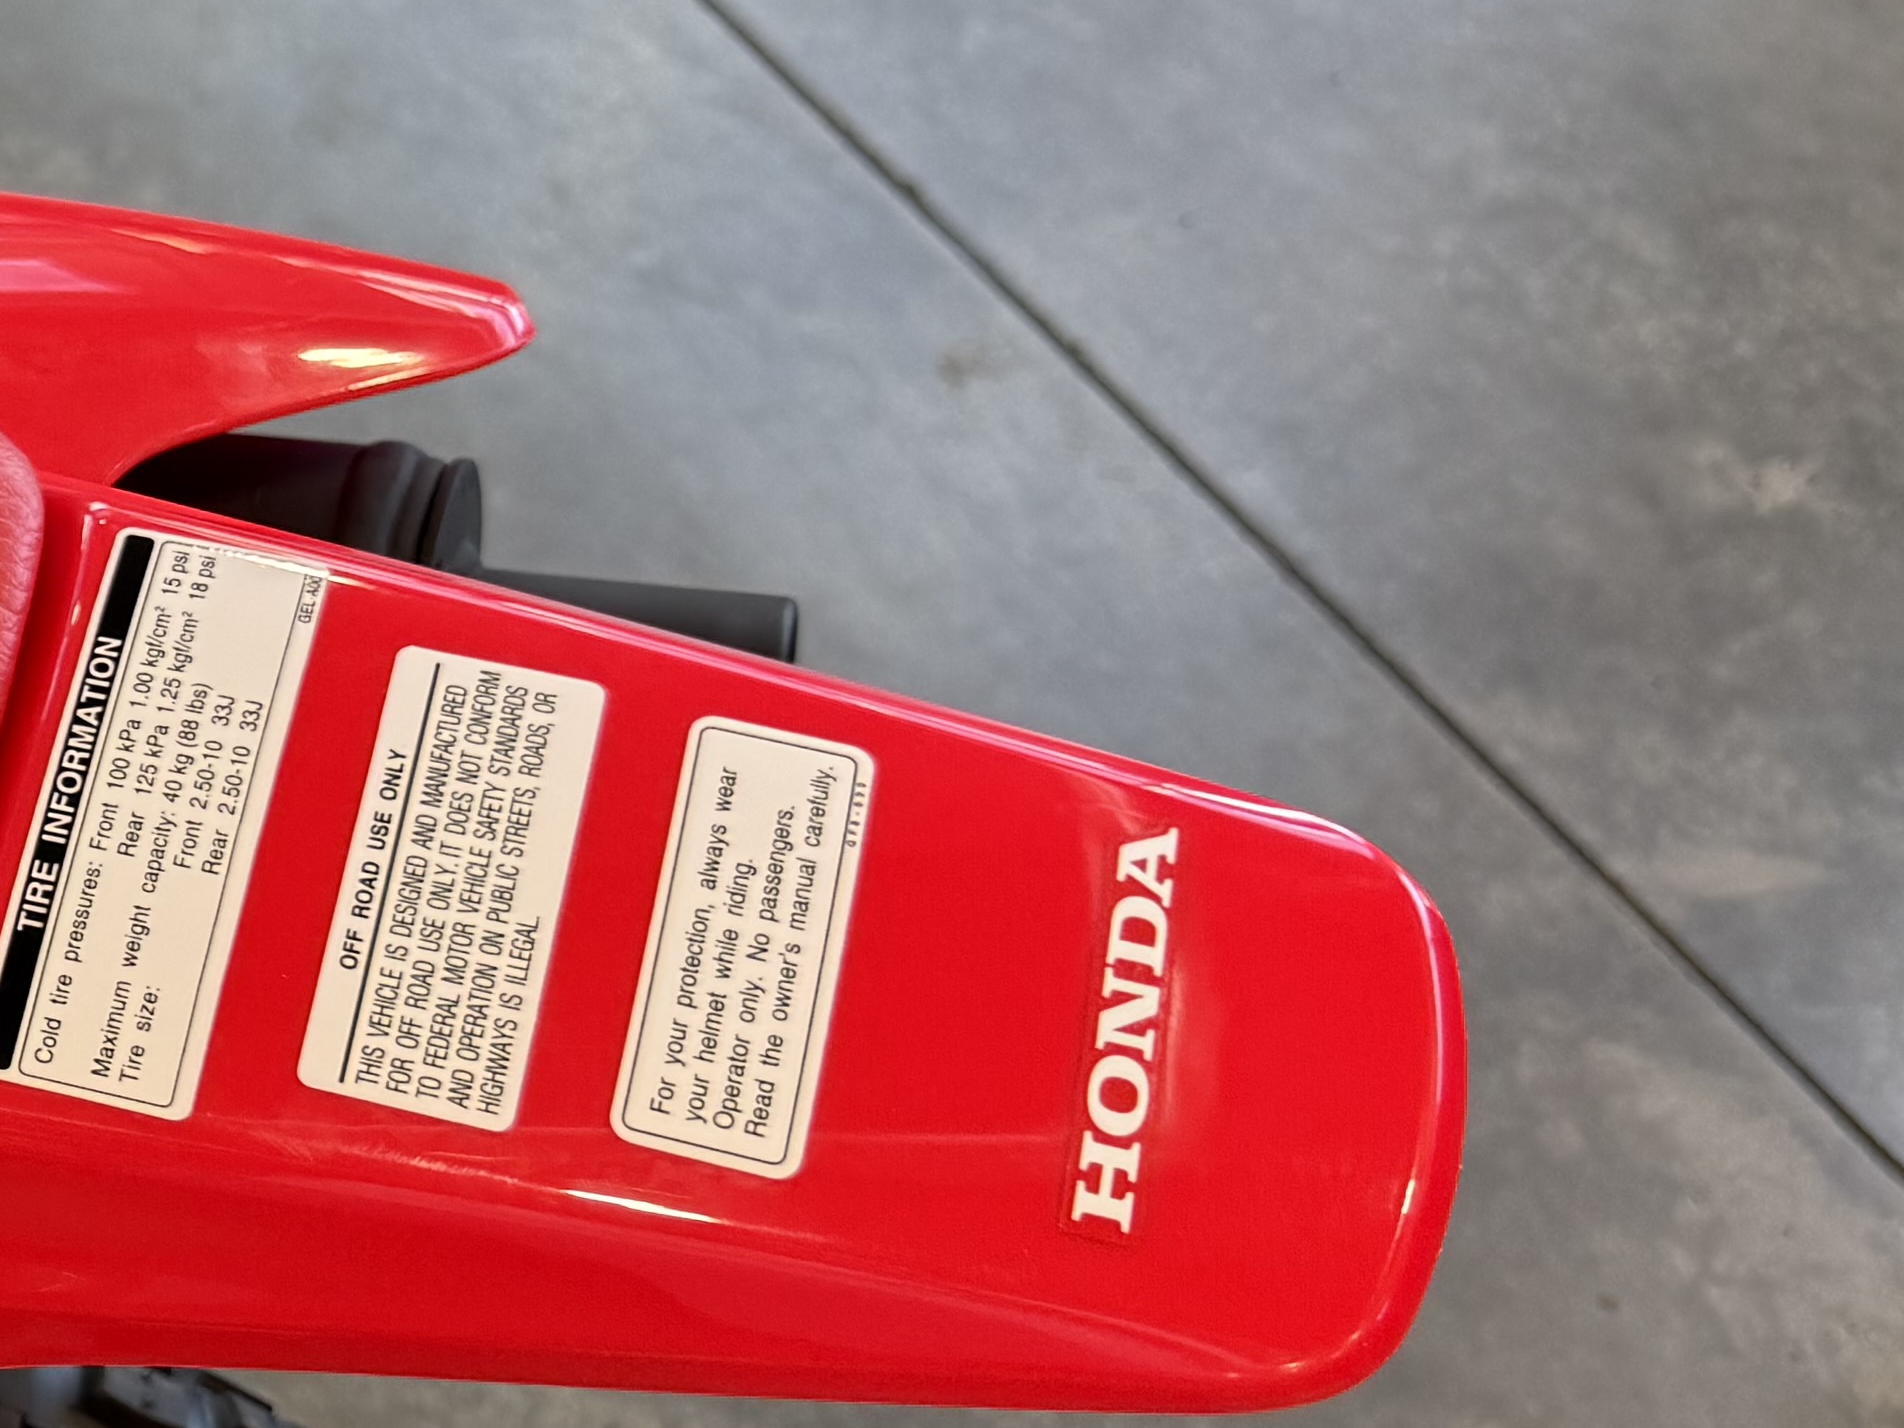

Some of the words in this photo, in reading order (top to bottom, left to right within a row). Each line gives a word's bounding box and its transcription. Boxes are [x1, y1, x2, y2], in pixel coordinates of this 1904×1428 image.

[161, 577, 182, 594] 15
[171, 550, 191, 575] psi
[198, 555, 217, 580] psi
[188, 582, 209, 599] 18
[128, 672, 155, 707] 1.00
[156, 677, 182, 712] 1.25
[184, 682, 214, 715] lbs)
[463, 670, 502, 746] CONFORM
[531, 691, 558, 715] OR
[115, 719, 142, 753] kPa
[143, 724, 170, 759] kPa
[175, 718, 200, 748] (88
[419, 684, 468, 809] MANUFACTURED
[487, 685, 529, 777] STANDARDS
[517, 722, 556, 778] ROADS,
[16, 859, 60, 931] TIRE
[41, 636, 123, 845] INFORMATION
[106, 757, 131, 788] 100
[133, 763, 159, 794] 125
[167, 753, 195, 775] kg
[200, 828, 229, 876] Rear
[217, 745, 251, 816] 2.50-10
[238, 700, 264, 732] 33J
[379, 748, 407, 801] ONLY
[454, 749, 483, 786] NOT
[715, 766, 738, 812] wear
[162, 779, 183, 803] 40
[443, 790, 475, 836] DOES
[472, 781, 507, 842] SAFETY
[804, 766, 838, 848] carefully.
[88, 802, 119, 852] Front
[116, 811, 145, 858] Rear
[366, 810, 393, 851] USE
[410, 814, 438, 851] AND
[499, 786, 541, 858] STREETS,
[141, 811, 178, 894] capacity:
[438, 840, 463, 859] IT
[697, 823, 730, 891] always
[758, 805, 795, 923] passengers.
[118, 1044, 146, 1082] Tire
[134, 985, 161, 1033] size:
[172, 819, 204, 869] Front
[188, 740, 224, 810] 2.50-10
[210, 694, 236, 727] 33J
[350, 861, 380, 920] ROAD
[388, 855, 429, 938] DESIGNED
[456, 846, 493, 913] VEHICLE
[485, 863, 520, 925] PUBLIC
[723, 859, 758, 917] riding.
[789, 857, 817, 931] manual
[64, 861, 103, 963] pressures:
[121, 905, 152, 967] weight
[416, 916, 446, 953] USE
[339, 928, 364, 970] OFF
[383, 943, 409, 962] IS
[440, 921, 477, 986] MOTOR
[478, 929, 506, 956] ON
[676, 904, 716, 1010] protection,
[712, 928, 740, 979] while
[745, 932, 771, 963] No
[49, 974, 73, 1005] tire
[365, 966, 404, 1037] VEHICLE
[403, 959, 436, 1011] ROAD
[738, 977, 766, 1024] only.
[771, 942, 802, 1022] owner's
[90, 980, 132, 1078] Maximum
[395, 1015, 423, 1050] OFF
[422, 994, 461, 1070] FEDERAL
[455, 962, 499, 1062] OPERATION
[692, 991, 728, 1064] helmet
[1071, 827, 1179, 1234] HONDA
[34, 1016, 62, 1064] Cold
[354, 1045, 386, 1085] THIS
[476, 1017, 518, 1116] HIGHWAYS
[498, 992, 524, 1012] IS
[664, 1017, 689, 1068] your
[759, 1034, 784, 1067] the
[385, 1057, 415, 1095] FOR
[414, 1075, 443, 1099] TO
[446, 1068, 475, 1110] AND
[649, 1076, 677, 1116] For
[685, 1073, 710, 1125] your
[712, 1033, 751, 1130] Operator
[743, 1078, 776, 1138] Read
